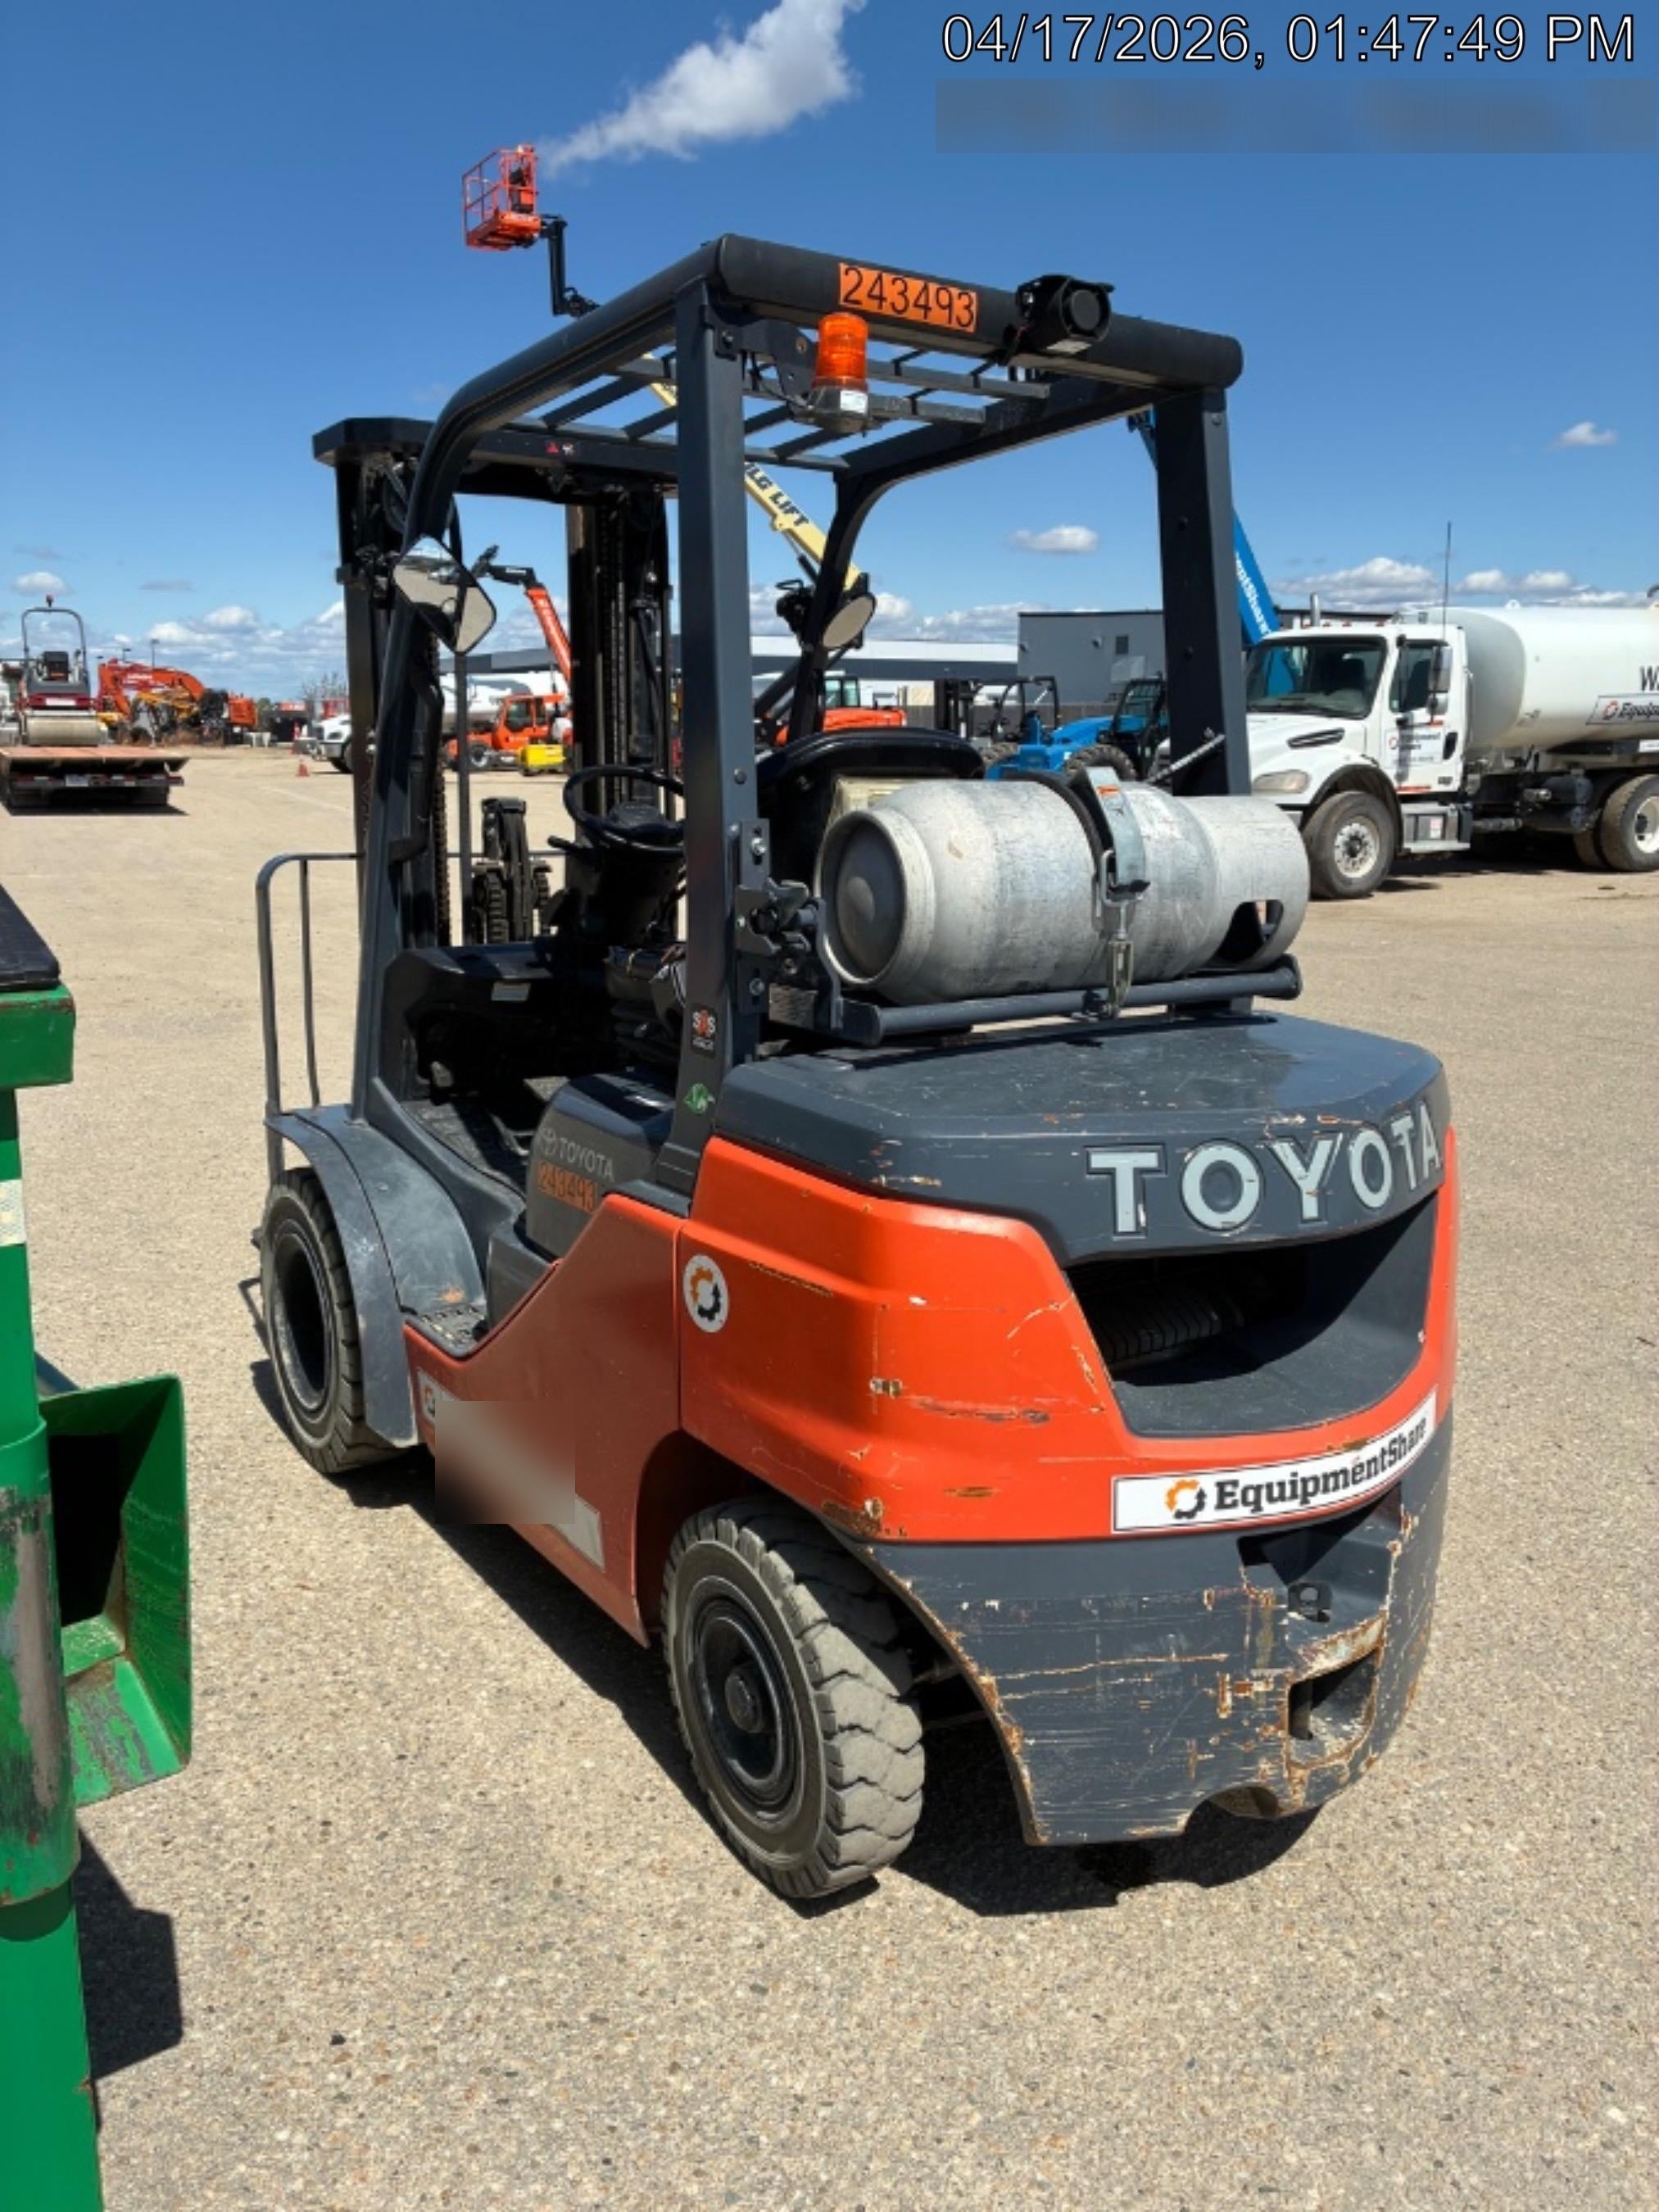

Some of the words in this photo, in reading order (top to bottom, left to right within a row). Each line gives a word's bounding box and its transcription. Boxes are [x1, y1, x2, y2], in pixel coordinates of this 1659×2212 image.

[843, 267, 975, 328] 243493
[768, 492, 809, 527] LIFT
[1639, 665, 1659, 691] W
[560, 1136, 615, 1183] TOYOTA
[1088, 1101, 1443, 1234] TOYOTA
[1214, 1417, 1428, 1514] EquipmentShare
